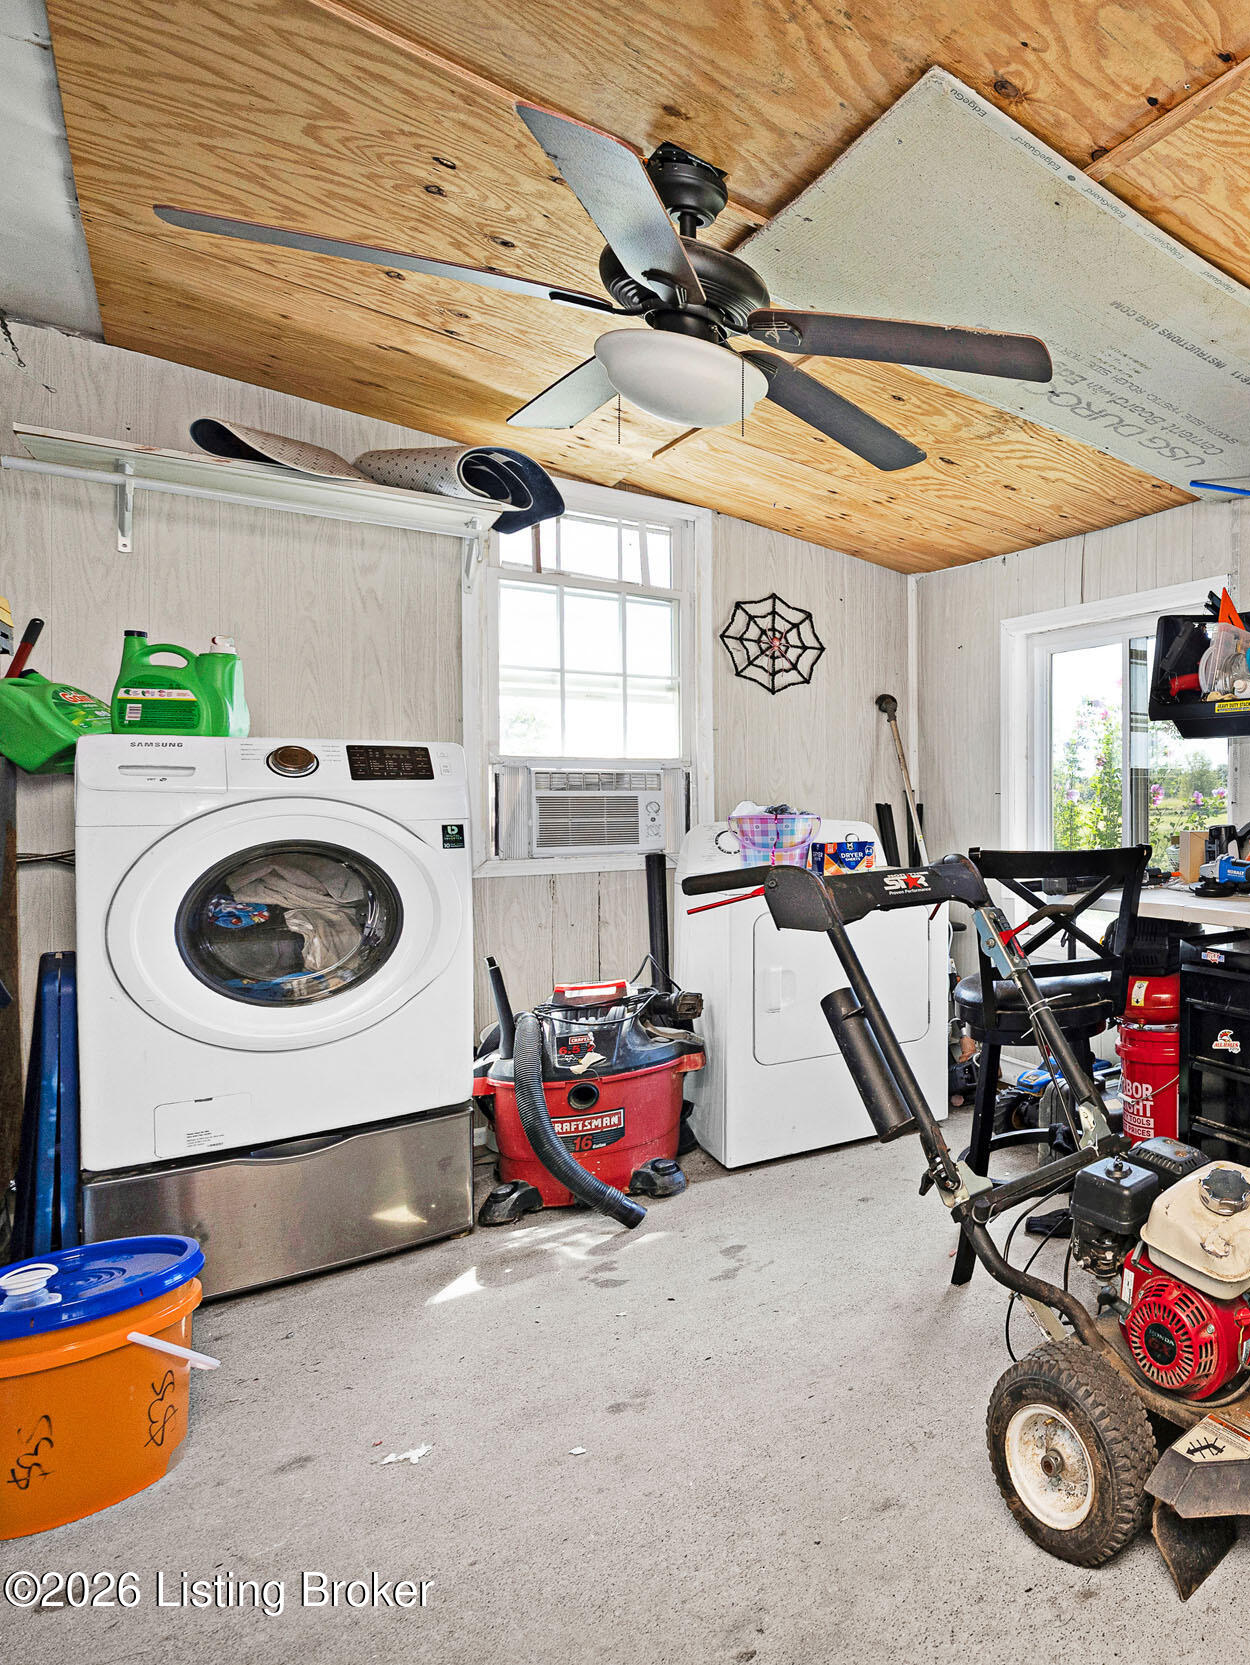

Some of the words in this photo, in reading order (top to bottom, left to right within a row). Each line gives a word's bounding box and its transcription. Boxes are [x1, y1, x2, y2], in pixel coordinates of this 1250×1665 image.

[1157, 323, 1227, 370] INSTRUCTIONS
[1106, 397, 1166, 426] Board
[1160, 423, 1224, 456] Cement
[1138, 436, 1206, 467] USG
[559, 1045, 580, 1054] 6.5
[554, 1115, 619, 1133] RAFTSMAN
[1129, 1115, 1151, 1126] TOOLS
[574, 1136, 592, 1151] 16
[1149, 1329, 1175, 1346] HONDA
